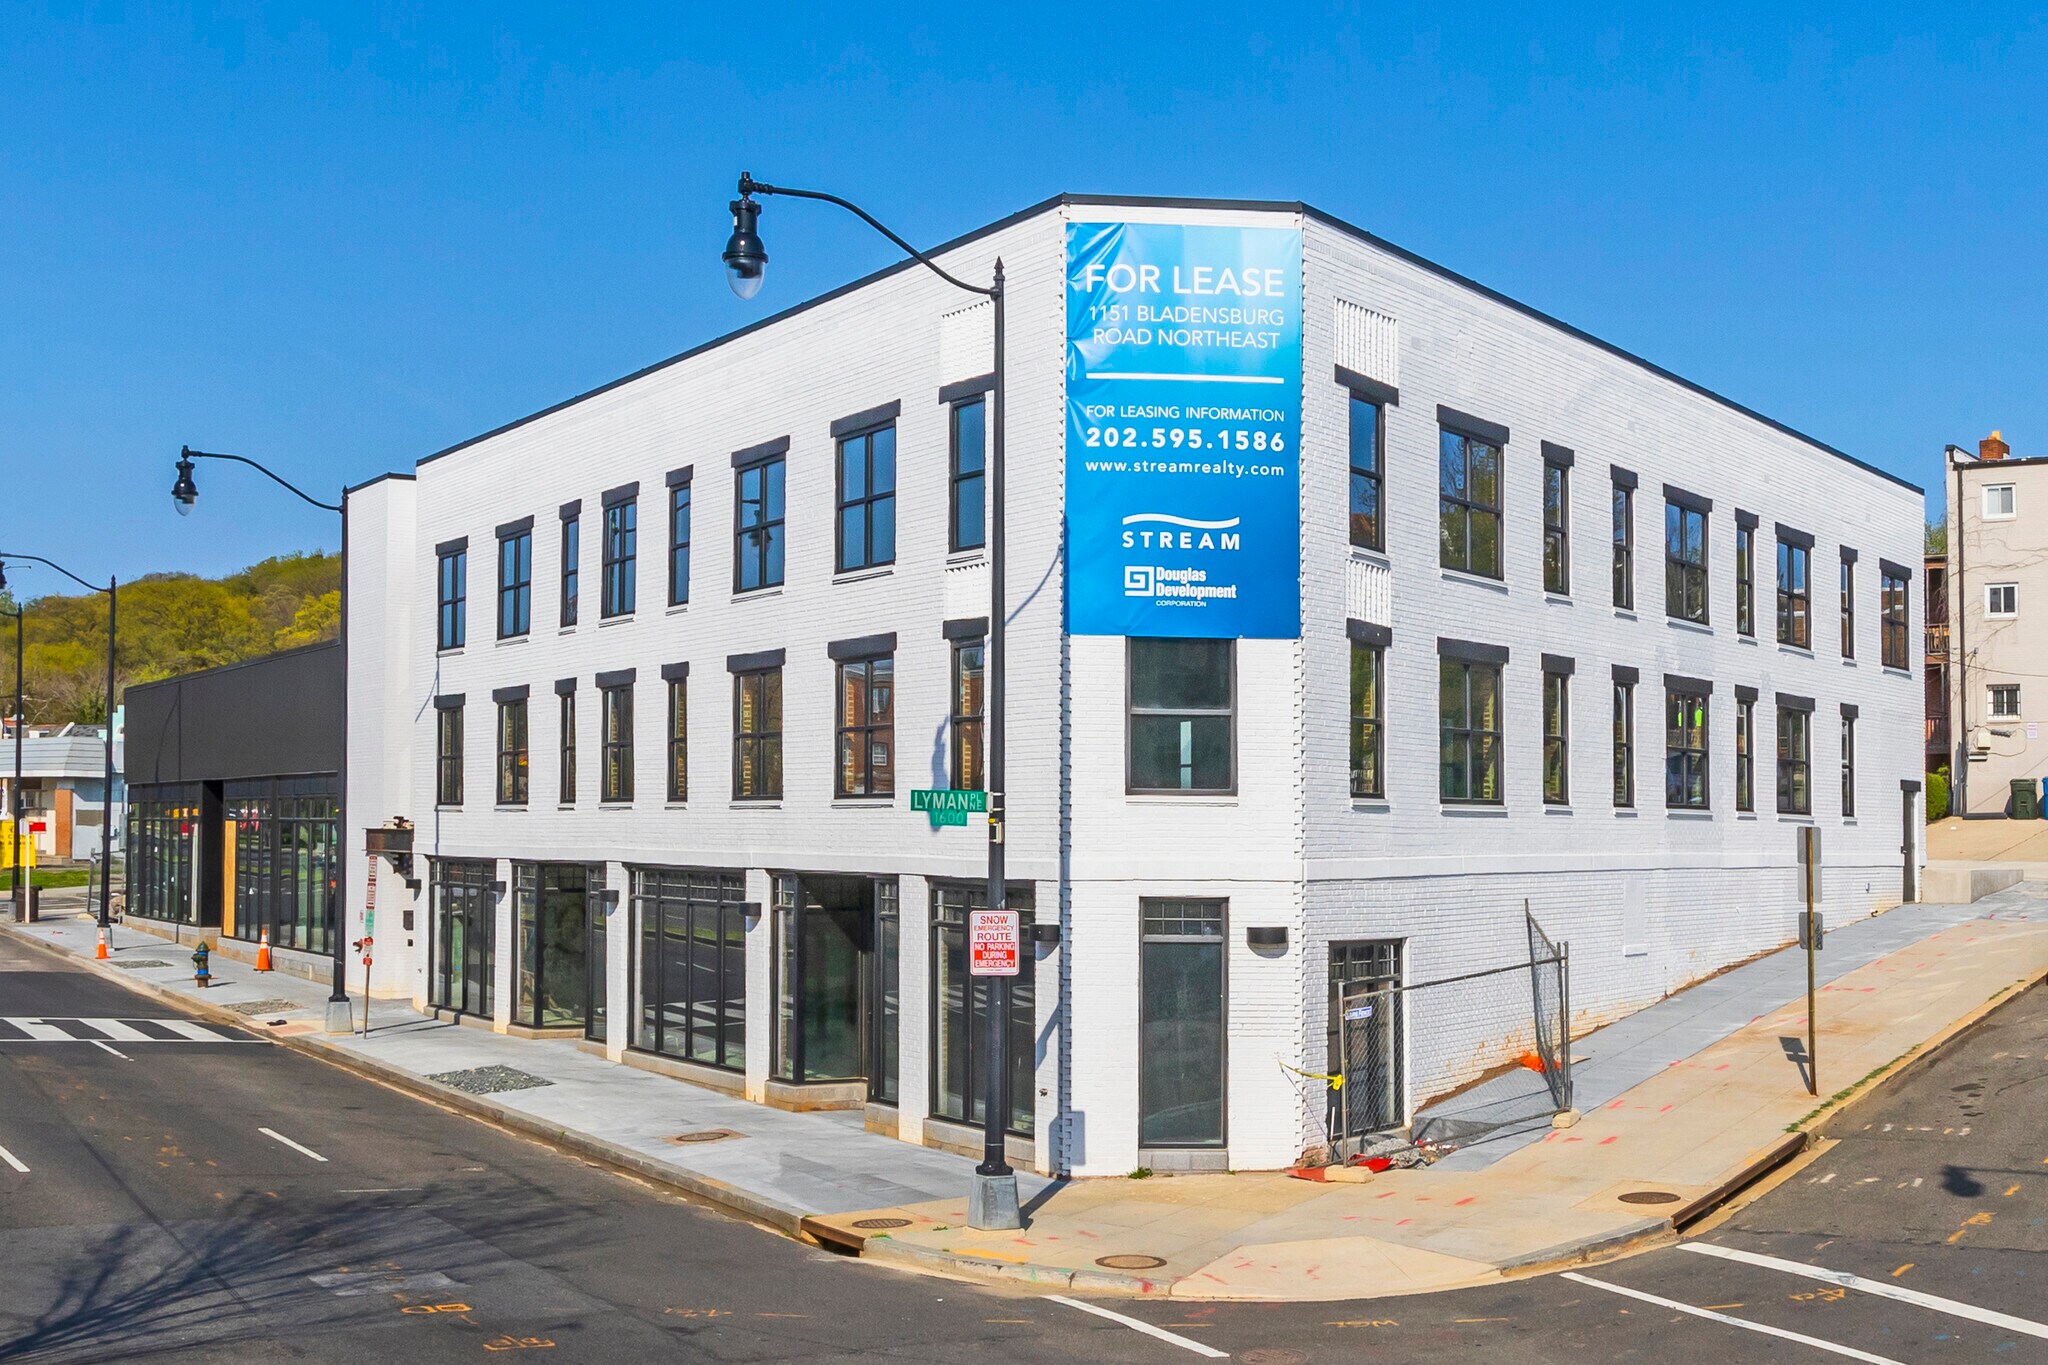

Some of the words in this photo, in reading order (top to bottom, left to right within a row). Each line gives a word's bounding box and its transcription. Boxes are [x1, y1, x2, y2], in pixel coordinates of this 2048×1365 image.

[1086, 264, 1161, 293] FOR
[1174, 266, 1285, 297] LEASE
[1089, 304, 1129, 322] 1151
[1137, 305, 1285, 326] BLADENSBURG
[1093, 328, 1152, 345] ROAD
[1158, 329, 1281, 349] NORTHEAST
[1086, 405, 1115, 418] FOR
[1120, 405, 1180, 418] LEASING
[1185, 407, 1285, 422] INFORMATION
[1086, 427, 1285, 452] 202.595.1586
[1085, 459, 1285, 478] www.streamrealty.com
[1122, 531, 1240, 550] STREAM
[1156, 566, 1206, 584] Douglas
[1156, 583, 1237, 600] Development
[914, 791, 968, 810] LYMAN
[970, 793, 981, 801] PL
[969, 801, 982, 810] NE
[934, 811, 964, 824] 1600
[980, 915, 1008, 924] SNOW
[977, 932, 1012, 941] ROUTE
[974, 943, 985, 951] NO
[986, 943, 1015, 951] PARKING
[982, 951, 1007, 959] DURING
[975, 959, 1015, 967] EMERGENCY
